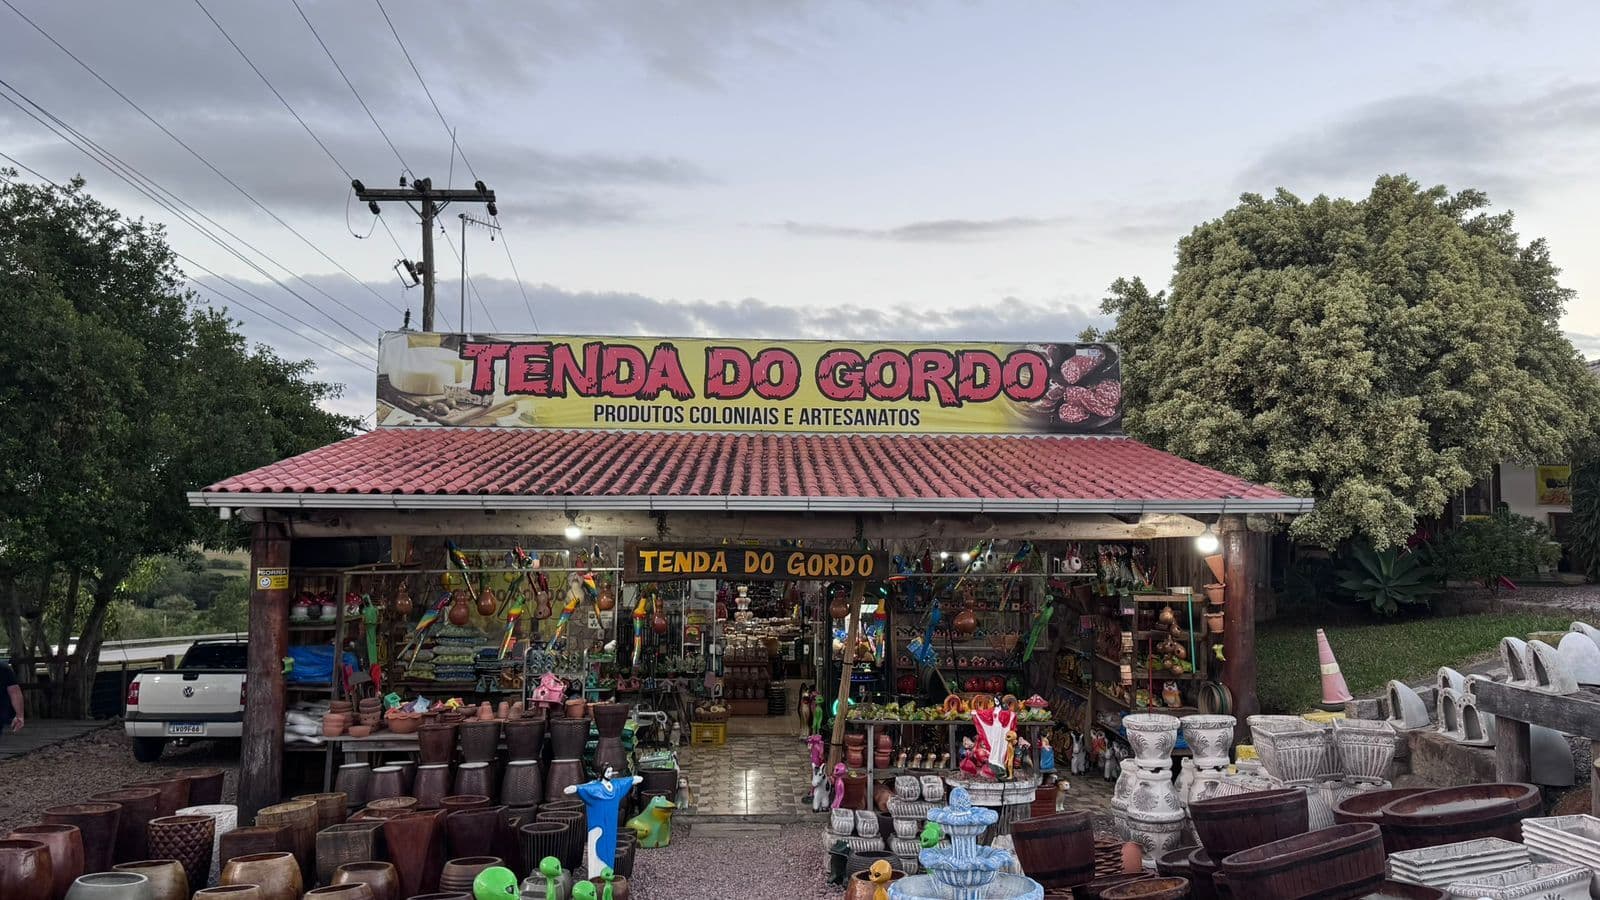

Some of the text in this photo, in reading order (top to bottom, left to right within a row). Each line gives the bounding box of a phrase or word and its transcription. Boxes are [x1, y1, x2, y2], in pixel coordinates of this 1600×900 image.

[459, 342, 1049, 408] TENDA DO GORDO
[594, 404, 920, 426] PRODUTOS COLONIAIS E ARTESANATOS
[639, 550, 874, 577] TENDA DO GORDO
